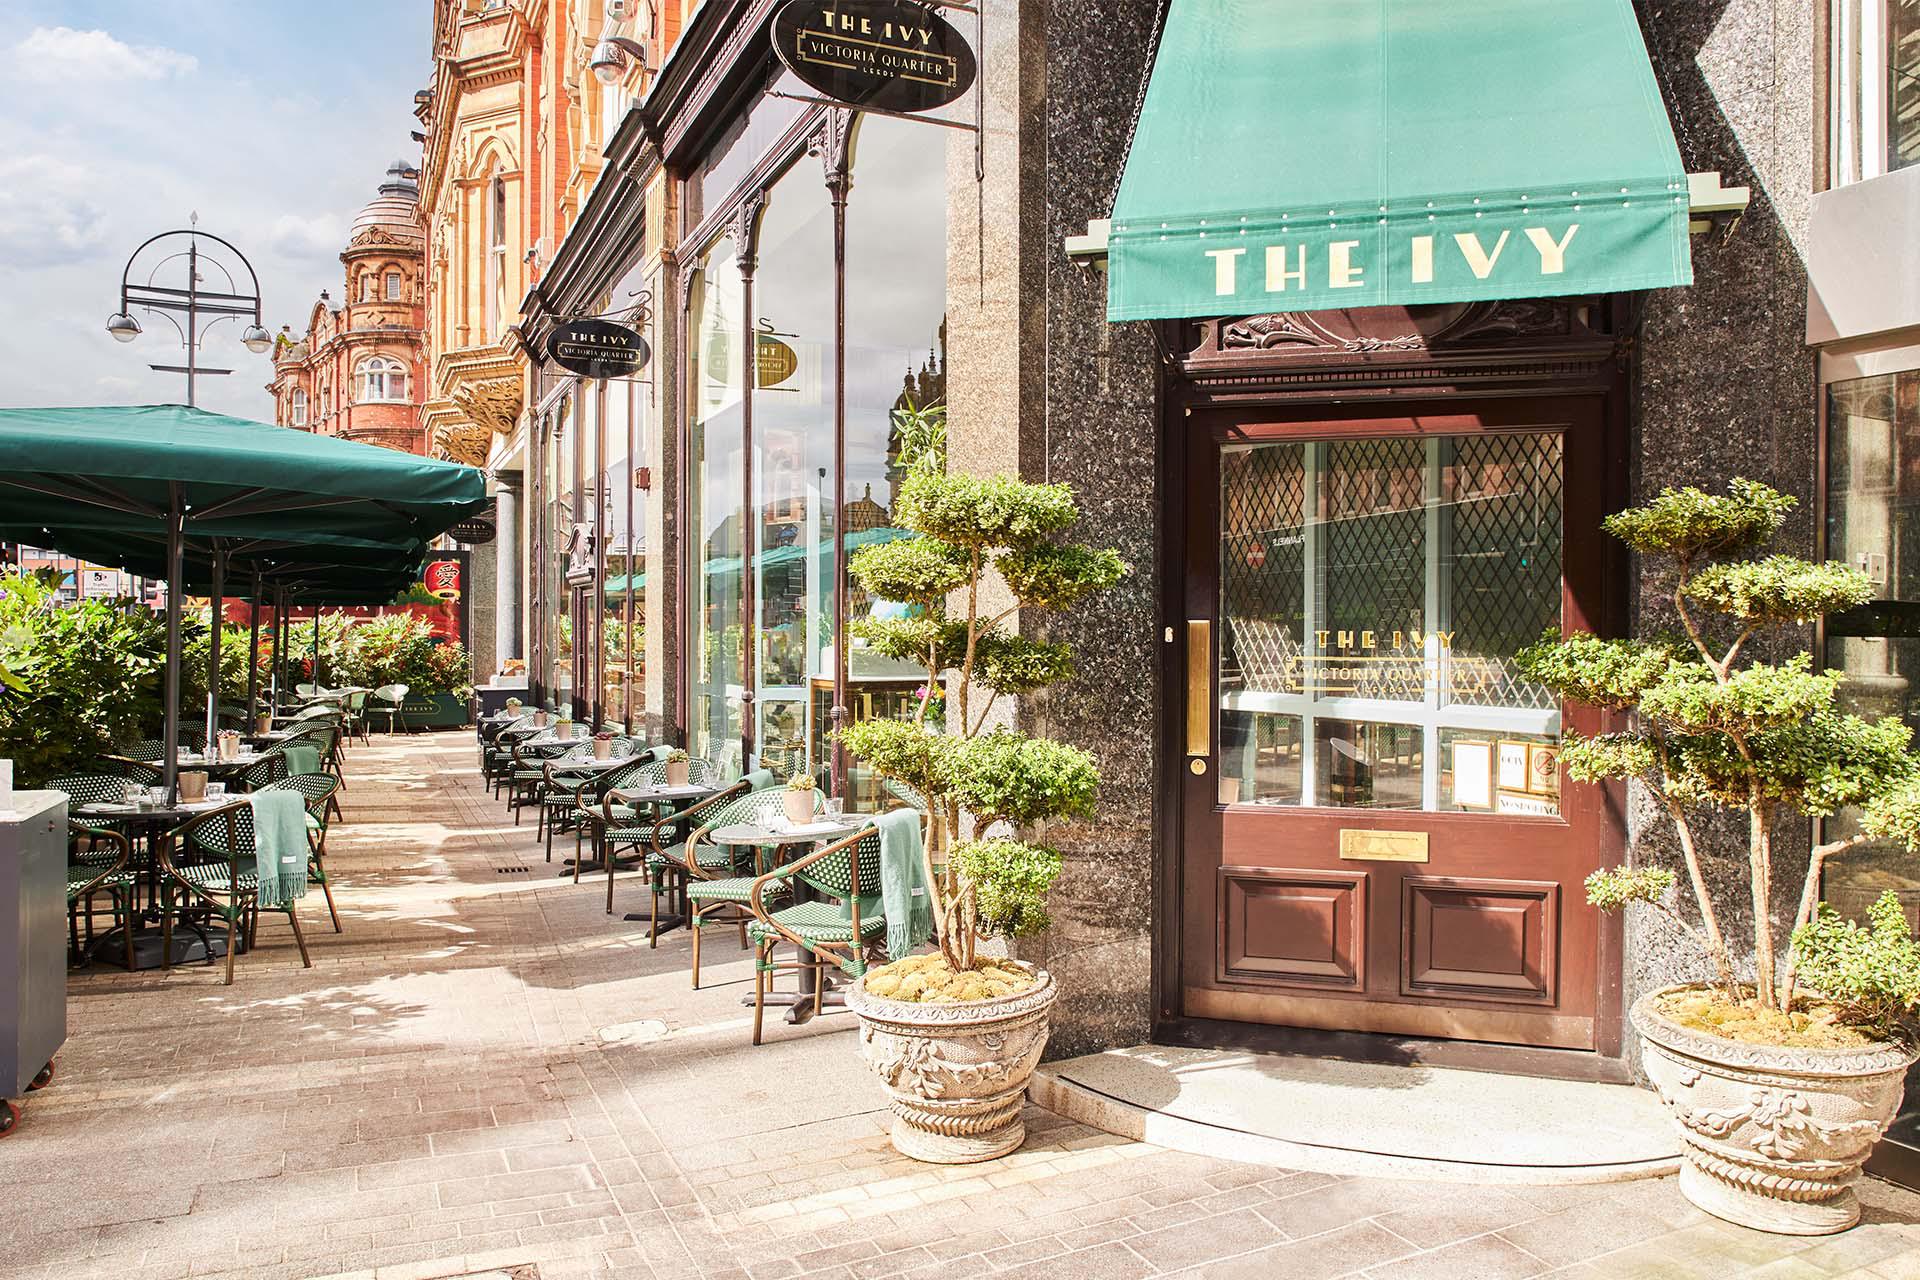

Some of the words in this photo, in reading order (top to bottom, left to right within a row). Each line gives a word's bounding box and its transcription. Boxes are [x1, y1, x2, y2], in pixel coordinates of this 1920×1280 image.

[822, 10, 872, 35] THE
[885, 22, 934, 46] IVY
[811, 41, 876, 64] VICTORIA
[881, 54, 943, 76] QUARTER
[863, 66, 895, 78] LEEDS
[1204, 240, 1365, 297] THE
[1411, 224, 1580, 284] IVY
[570, 332, 597, 343] THE
[602, 335, 629, 345] IVY
[564, 346, 598, 357] VICTORIA
[600, 351, 634, 360] QUARTER
[436, 564, 459, 588] 愛
[1314, 630, 1376, 649] THE
[1393, 630, 1456, 650] IVY
[1302, 667, 1381, 681] VICTORIA
